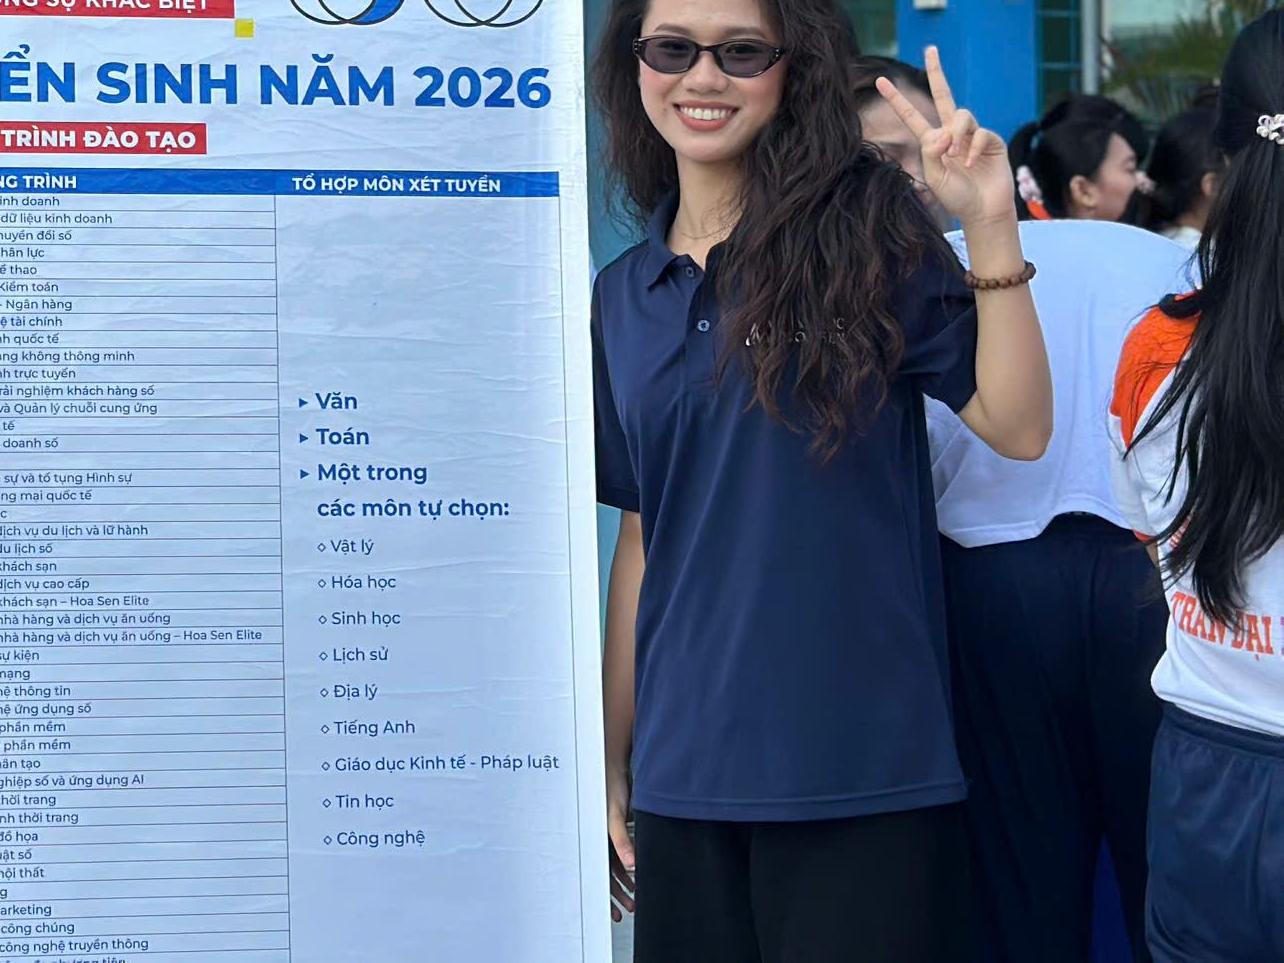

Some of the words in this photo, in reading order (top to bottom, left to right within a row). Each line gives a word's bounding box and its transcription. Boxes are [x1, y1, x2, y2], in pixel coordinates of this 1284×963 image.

[96, 61, 237, 104] SINH
[259, 53, 394, 106] NĂM
[412, 66, 551, 108] 2026
[0, 125, 75, 147] TRÌNH
[82, 125, 138, 147] ĐÀO
[145, 131, 196, 152] TẠO
[22, 172, 76, 188] TRÌNH
[291, 173, 316, 190] TỔ
[321, 175, 358, 193] HỢP
[363, 175, 404, 191] MÔN
[408, 175, 441, 191] XÉT
[444, 174, 500, 192] TUYỂN
[21, 196, 59, 206] doanh
[0, 212, 17, 223] dữ
[20, 212, 41, 225] liệu
[45, 213, 70, 223] kinh
[74, 213, 112, 223] doanh
[10, 315, 25, 326] tài
[28, 315, 62, 326] chính
[13, 402, 46, 414] Quản
[50, 402, 60, 415] lý
[63, 401, 96, 413] chuỗi
[99, 405, 130, 415] cung
[133, 402, 157, 415] ứng
[314, 391, 357, 409] Văn
[2, 419, 15, 430] tế
[315, 427, 369, 444] Toán
[318, 462, 360, 485] Một
[366, 464, 427, 484] trong
[317, 498, 355, 516] các
[362, 498, 411, 516] môn
[418, 499, 442, 520] tự
[448, 498, 509, 520] chọn:
[330, 539, 356, 555] Vật
[361, 538, 374, 555] lý
[35, 563, 56, 573] sạn
[331, 574, 362, 588] Hóa
[367, 574, 396, 591] học
[331, 610, 366, 624] Sinh
[371, 610, 400, 627] học
[333, 647, 365, 664] Lịch
[369, 646, 388, 660] sử
[14, 685, 51, 698] thông
[54, 685, 70, 696] tin
[333, 683, 359, 700] Địa
[364, 683, 377, 700] lý
[333, 719, 378, 737] Tiếng
[382, 719, 415, 733] Anh
[335, 756, 370, 771] Giáo
[375, 756, 404, 773] dục
[410, 755, 445, 769] Kinh
[450, 754, 465, 769] tế
[481, 754, 522, 771] Pháp
[527, 754, 559, 771] luật
[34, 774, 49, 786] số
[51, 775, 65, 786] và
[69, 775, 92, 787] ứng
[96, 774, 128, 787] dụng
[131, 774, 143, 784] AI
[335, 794, 359, 808] Tin
[365, 793, 394, 810] học
[336, 831, 378, 848] Công
[384, 829, 425, 847] nghệ
[17, 848, 32, 859] số
[33, 940, 65, 954] nghệ
[68, 938, 108, 952] truyền
[111, 938, 148, 951] thông
